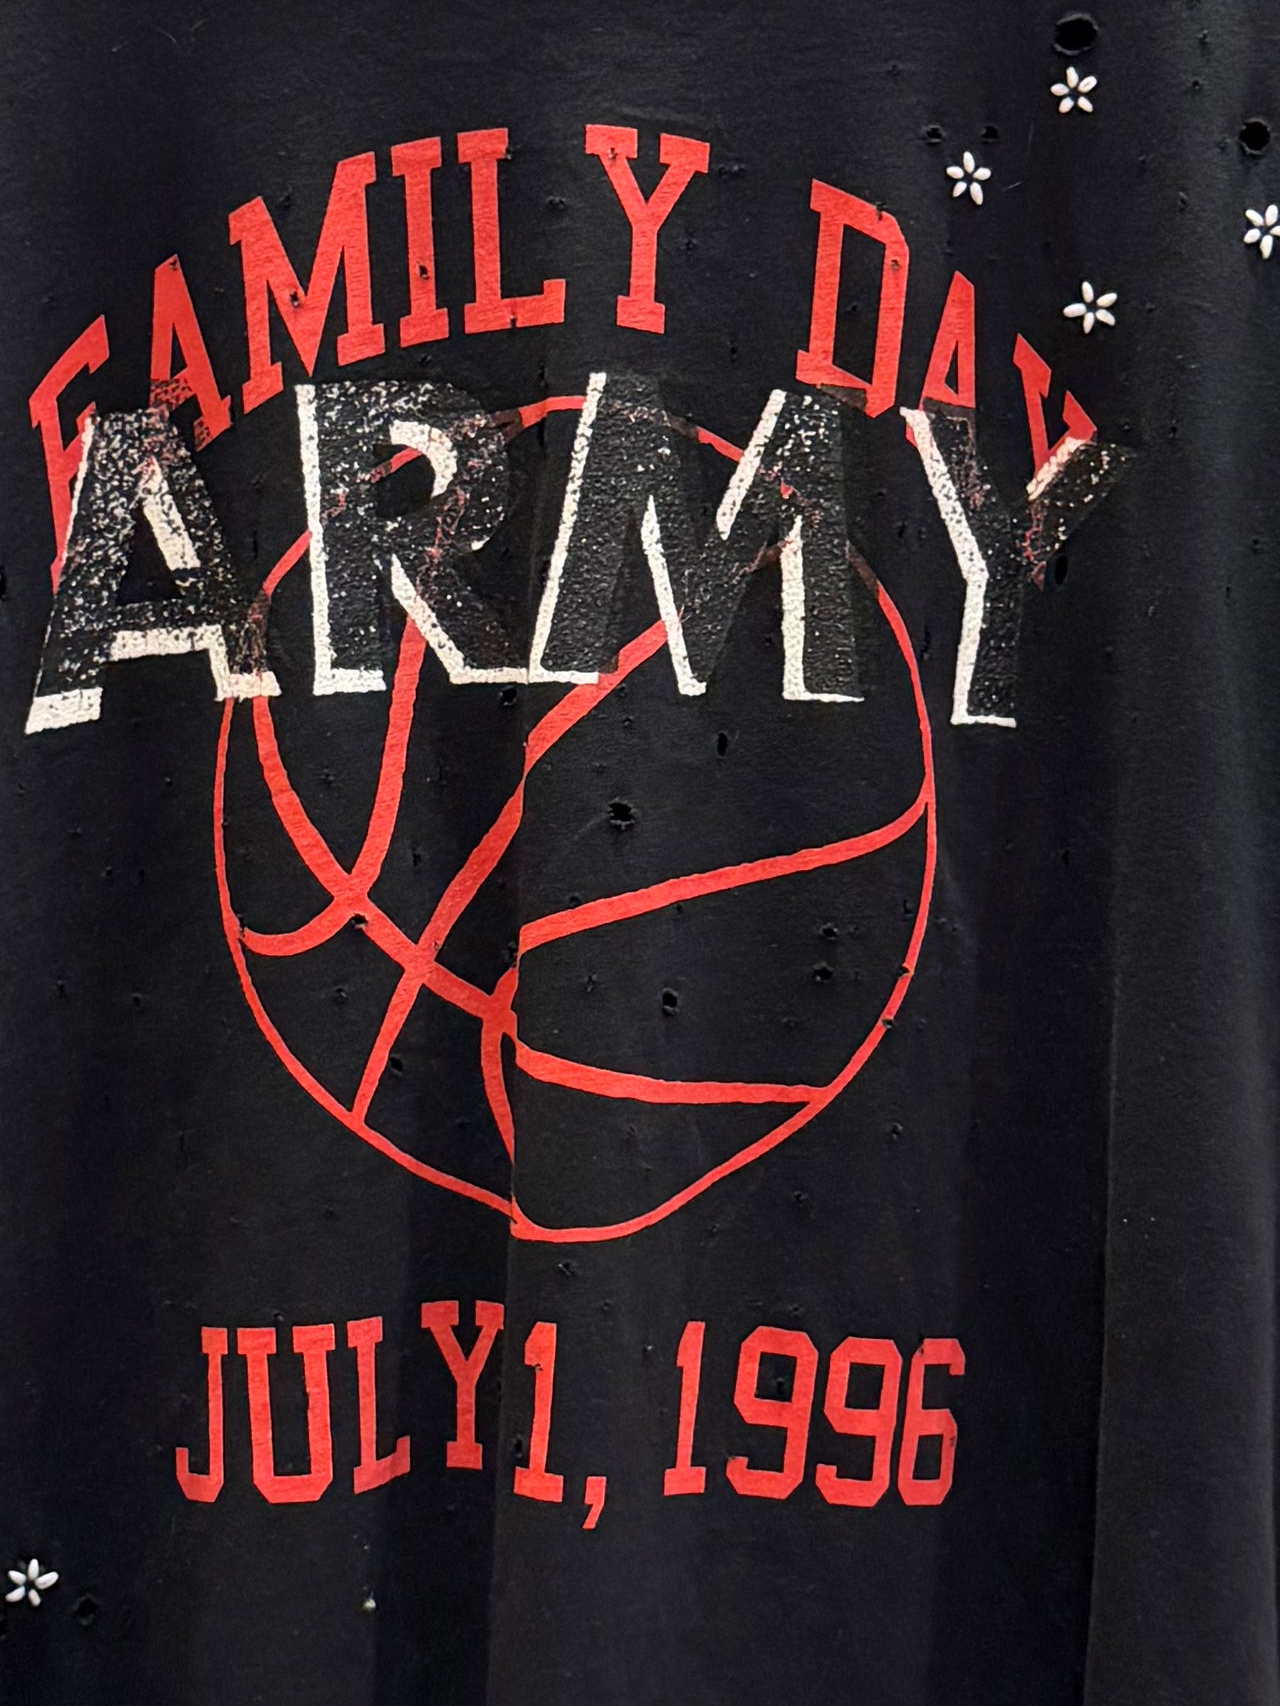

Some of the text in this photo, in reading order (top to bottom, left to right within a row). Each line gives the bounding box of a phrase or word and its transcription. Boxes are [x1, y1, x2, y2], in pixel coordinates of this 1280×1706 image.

[28, 124, 710, 593] FAMILY
[25, 370, 1133, 735] ARMY
[663, 1320, 966, 1508] 1996
